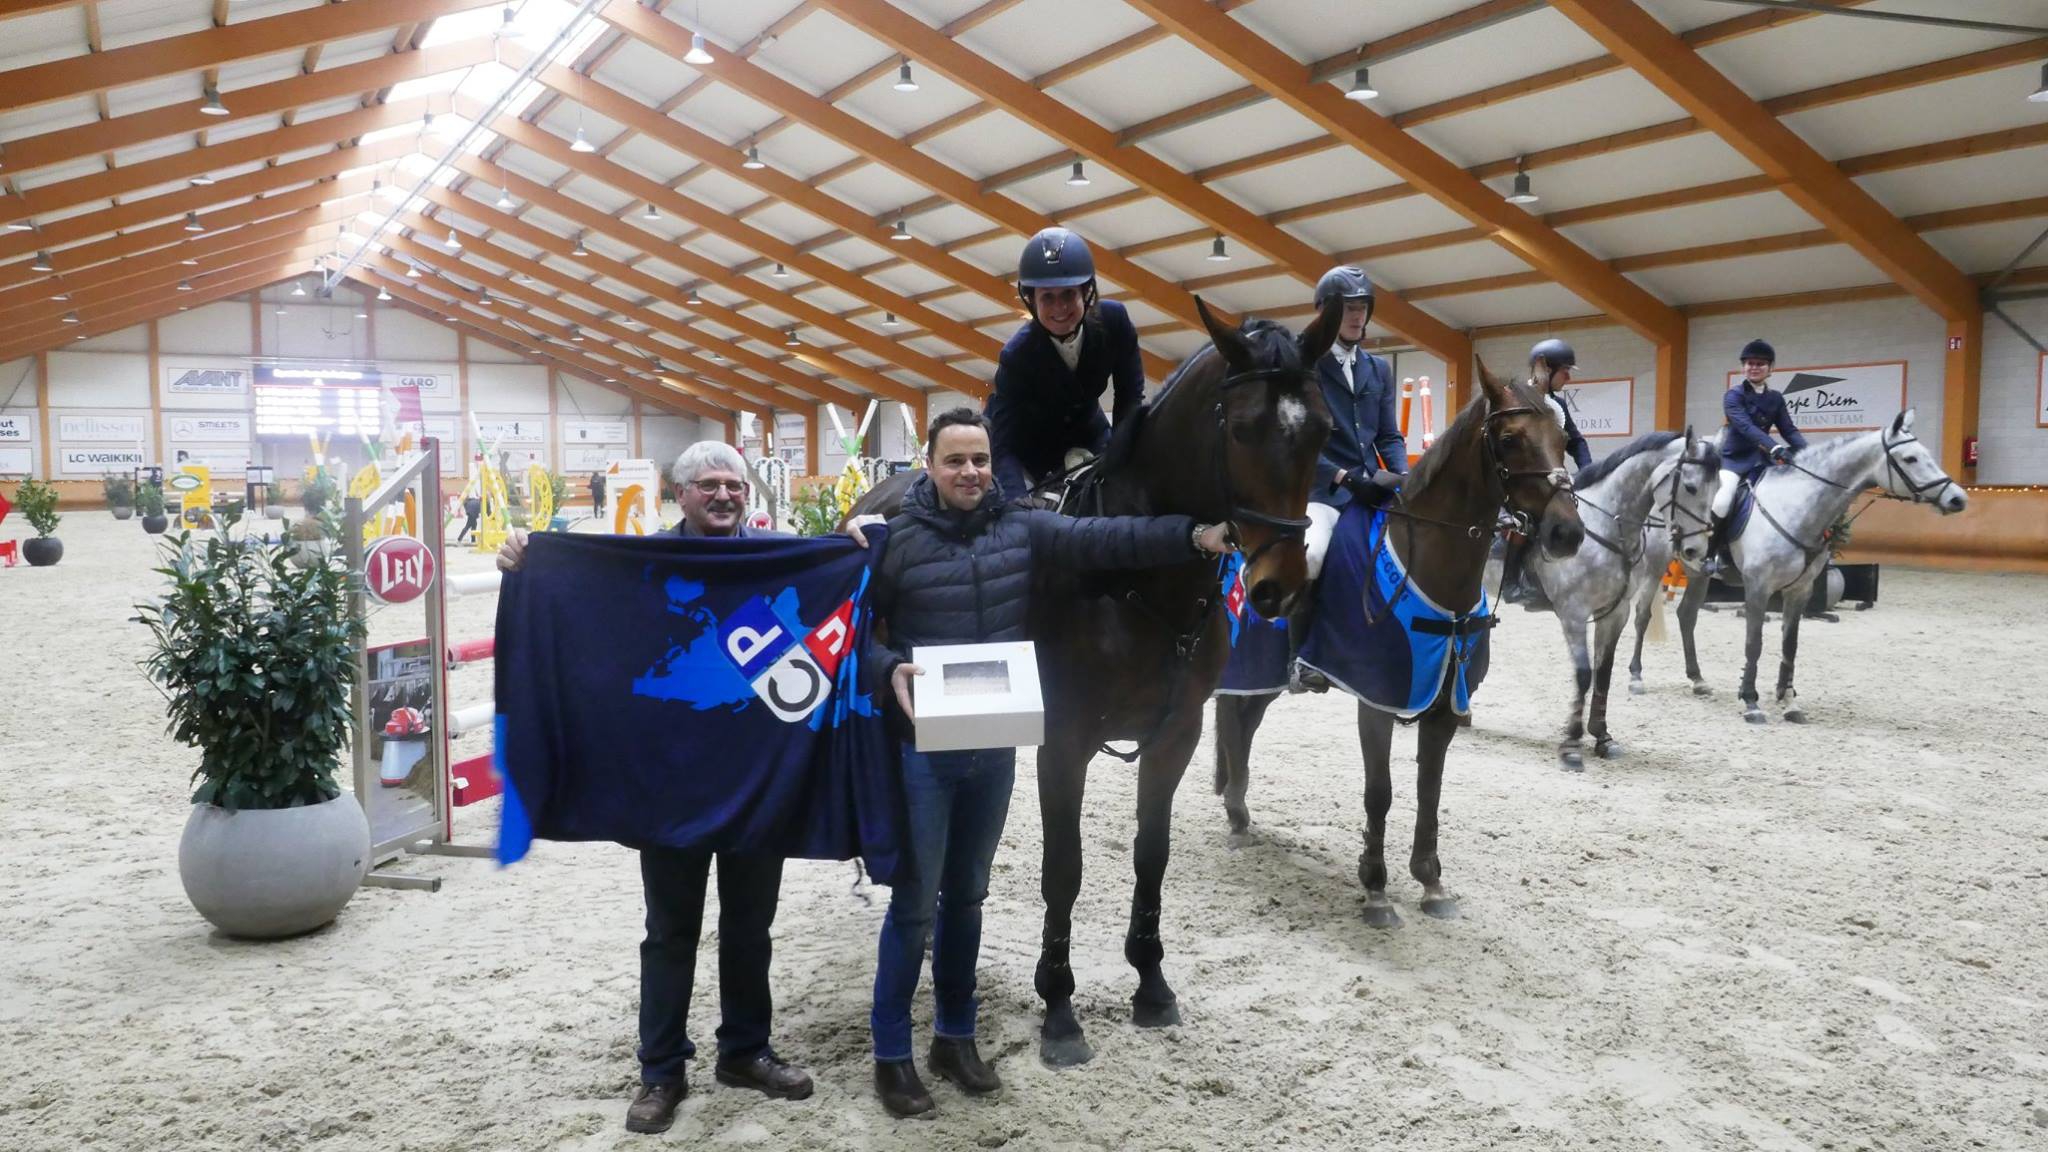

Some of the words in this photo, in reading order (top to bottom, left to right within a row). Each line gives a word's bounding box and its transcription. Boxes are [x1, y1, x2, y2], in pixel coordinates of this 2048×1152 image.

[401, 378, 434, 388] CARO
[1787, 397, 1810, 415] rpe
[1816, 390, 1858, 410] Diem
[0, 419, 14, 428] ut
[1832, 413, 1864, 424] TEAM
[1575, 418, 1612, 430] DRIX
[0, 429, 20, 437] ses
[68, 453, 86, 463] LC
[380, 548, 424, 595] LELY
